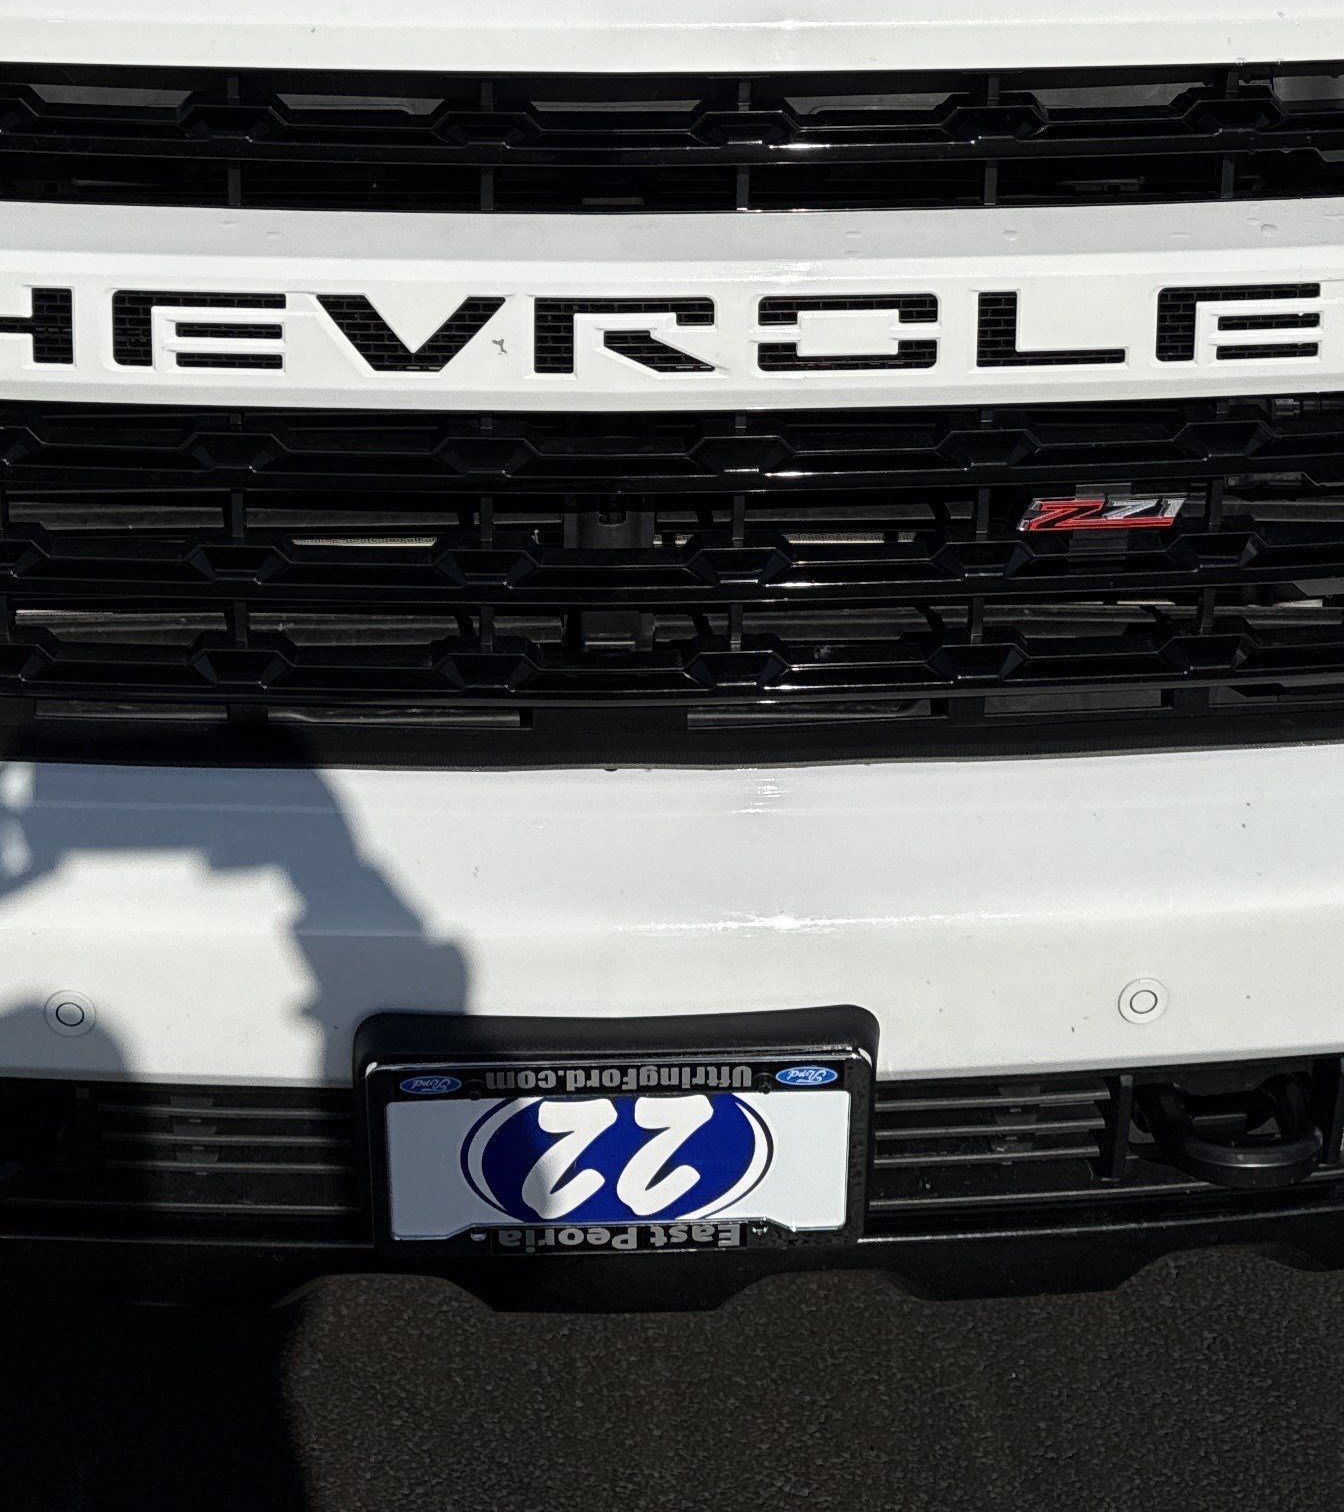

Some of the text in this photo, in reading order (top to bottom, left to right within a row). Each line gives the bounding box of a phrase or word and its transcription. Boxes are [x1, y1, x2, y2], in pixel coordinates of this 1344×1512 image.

[1017, 497, 1187, 531] Z71
[485, 1065, 752, 1092] UftringFord.com
[522, 1095, 713, 1218] 22
[498, 1224, 741, 1253] East Peoria
